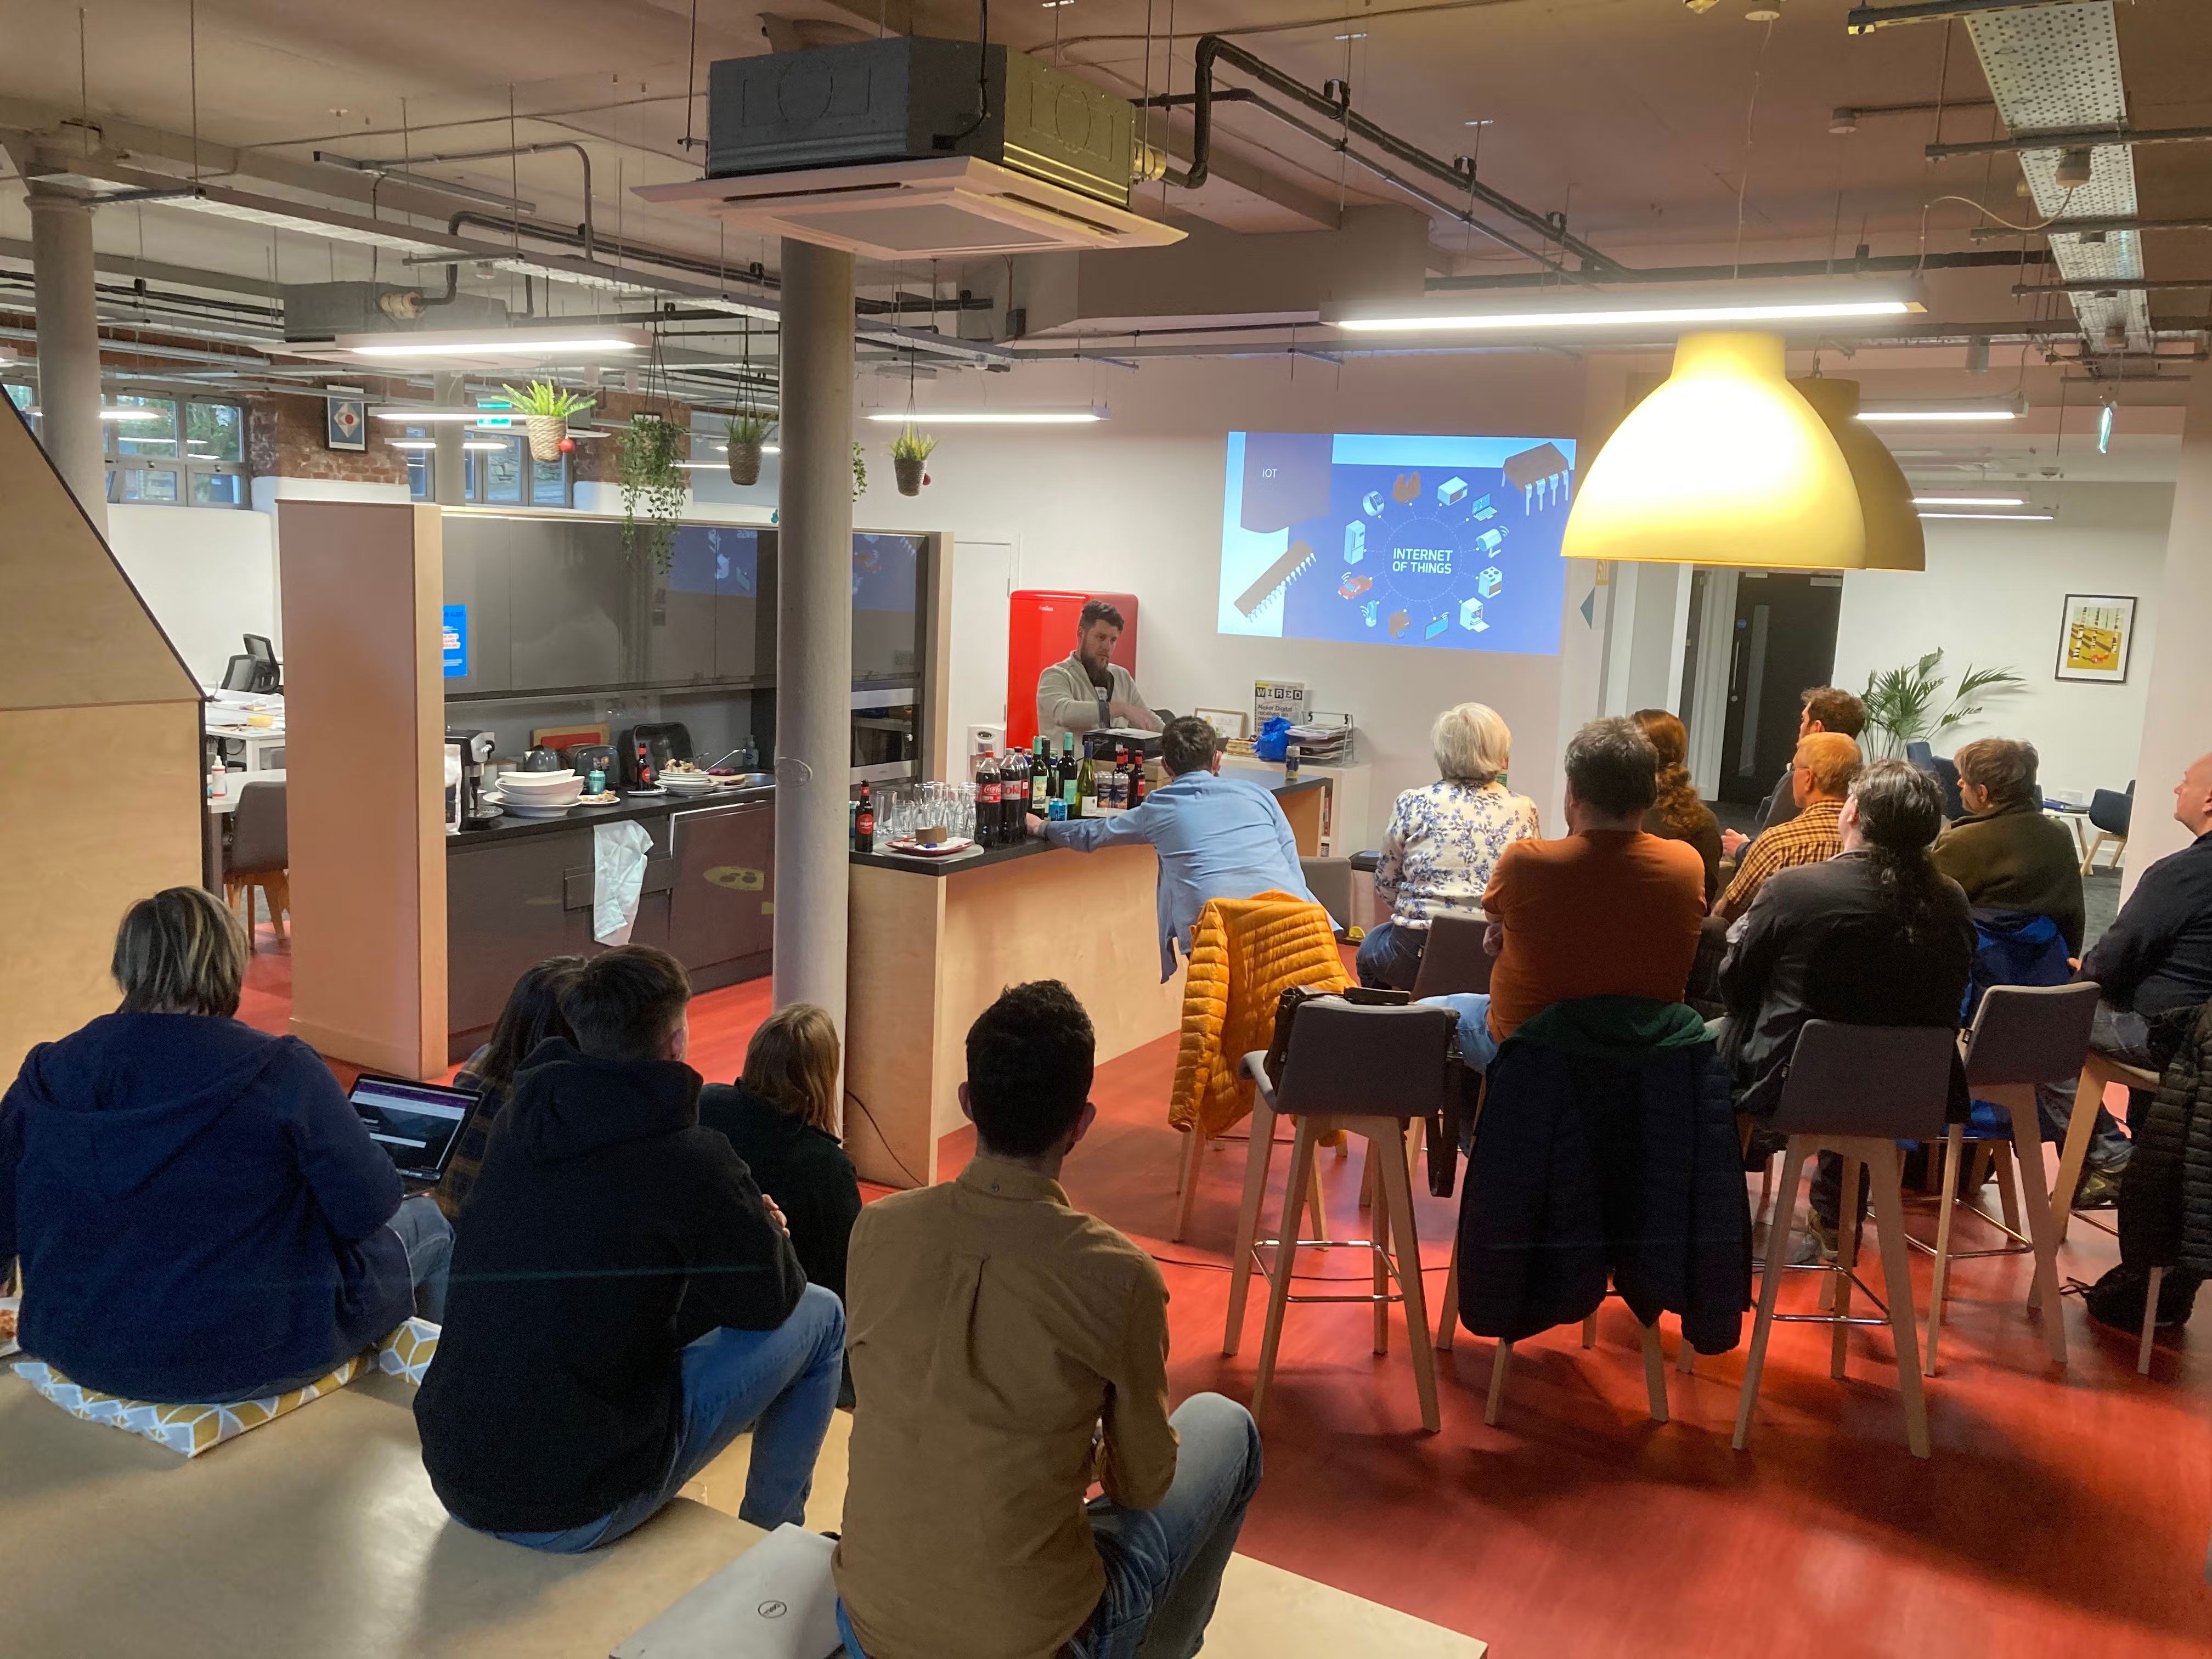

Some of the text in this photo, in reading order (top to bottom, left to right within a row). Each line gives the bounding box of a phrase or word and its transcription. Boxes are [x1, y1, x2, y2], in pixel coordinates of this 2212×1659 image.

[1263, 468, 1278, 478] IOT
[1393, 548, 1453, 562] INTERNET
[1392, 561, 1452, 574] OF THINGS
[1256, 687, 1303, 700] WIRED
